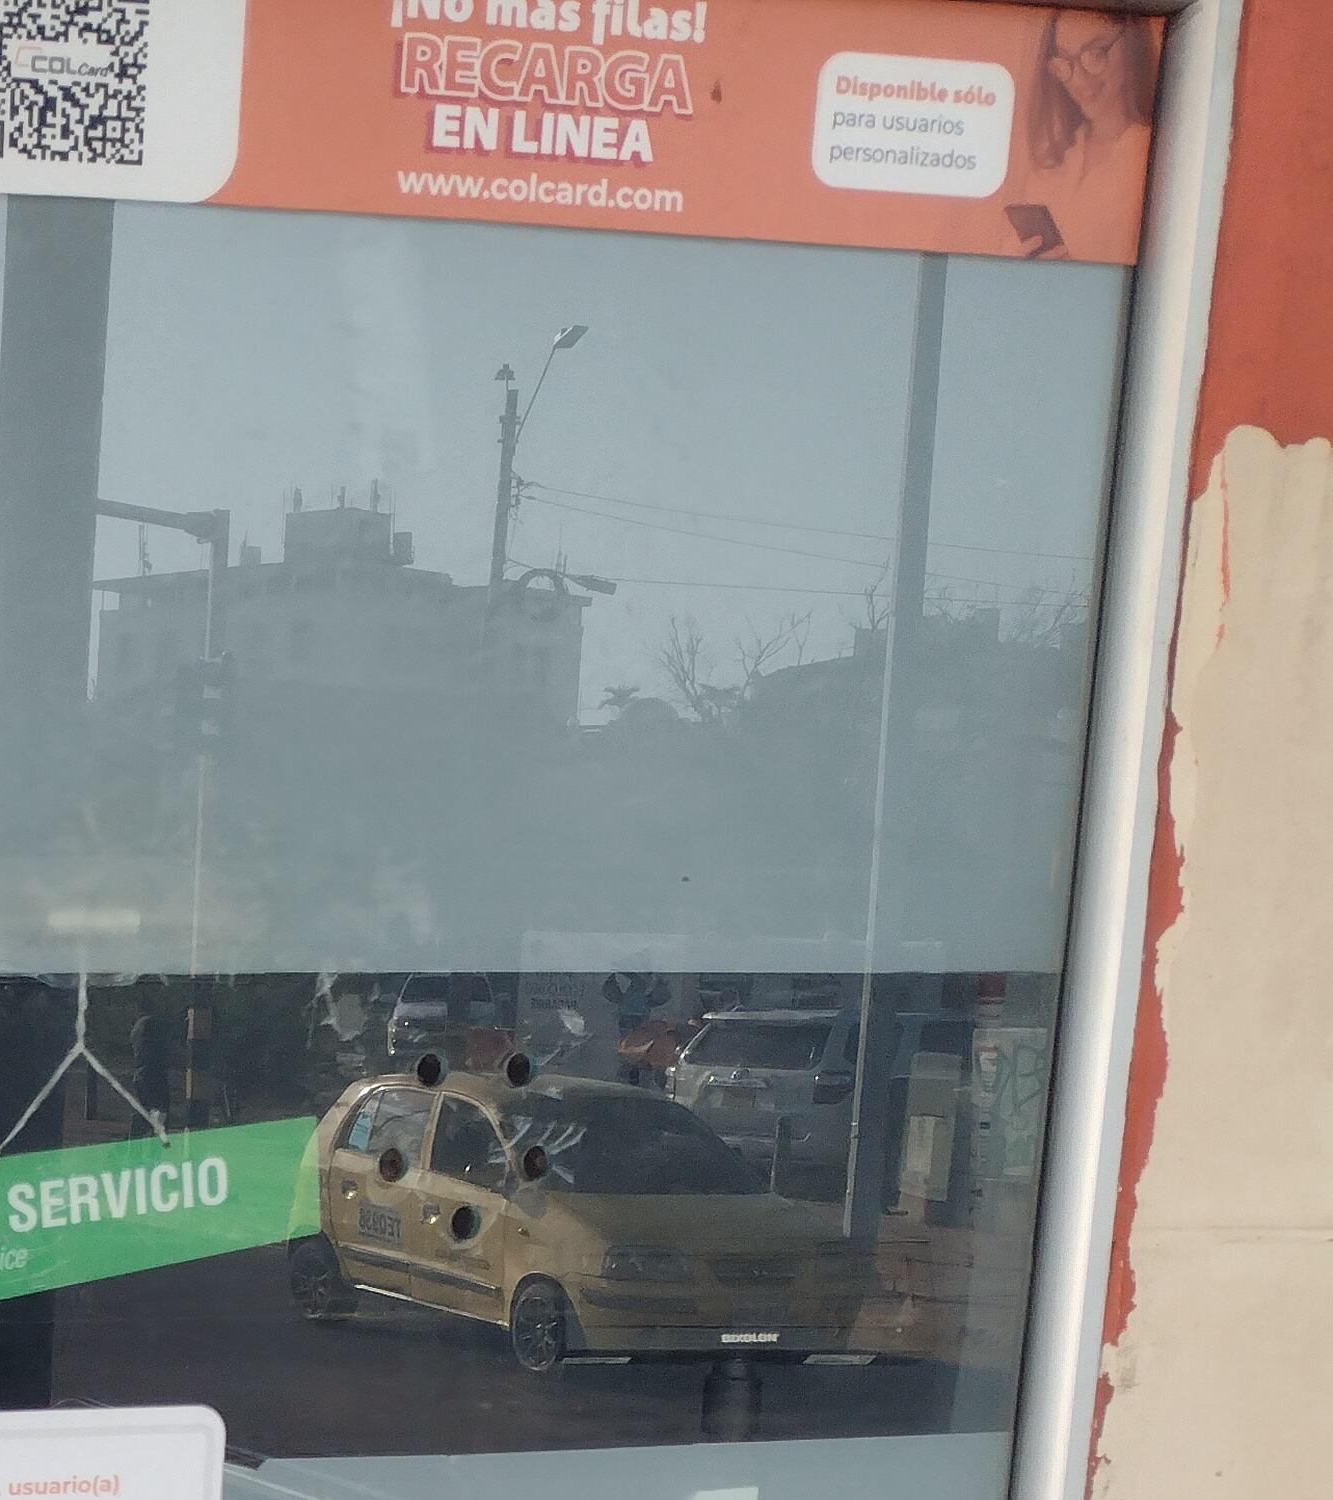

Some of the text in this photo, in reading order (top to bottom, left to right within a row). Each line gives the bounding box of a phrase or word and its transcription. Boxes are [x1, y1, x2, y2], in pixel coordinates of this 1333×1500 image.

[592, 0, 708, 45] filas!
[398, 31, 694, 115] RECARGA
[836, 75, 997, 106] Disponible sólo
[432, 104, 654, 163] EN LINEA
[832, 111, 965, 136] para usuarios
[829, 144, 977, 170] personalizados
[397, 170, 684, 213] www.colcard.com
[7, 1156, 229, 1233] SERVICIO
[8, 1475, 120, 1497] usuario(a)
